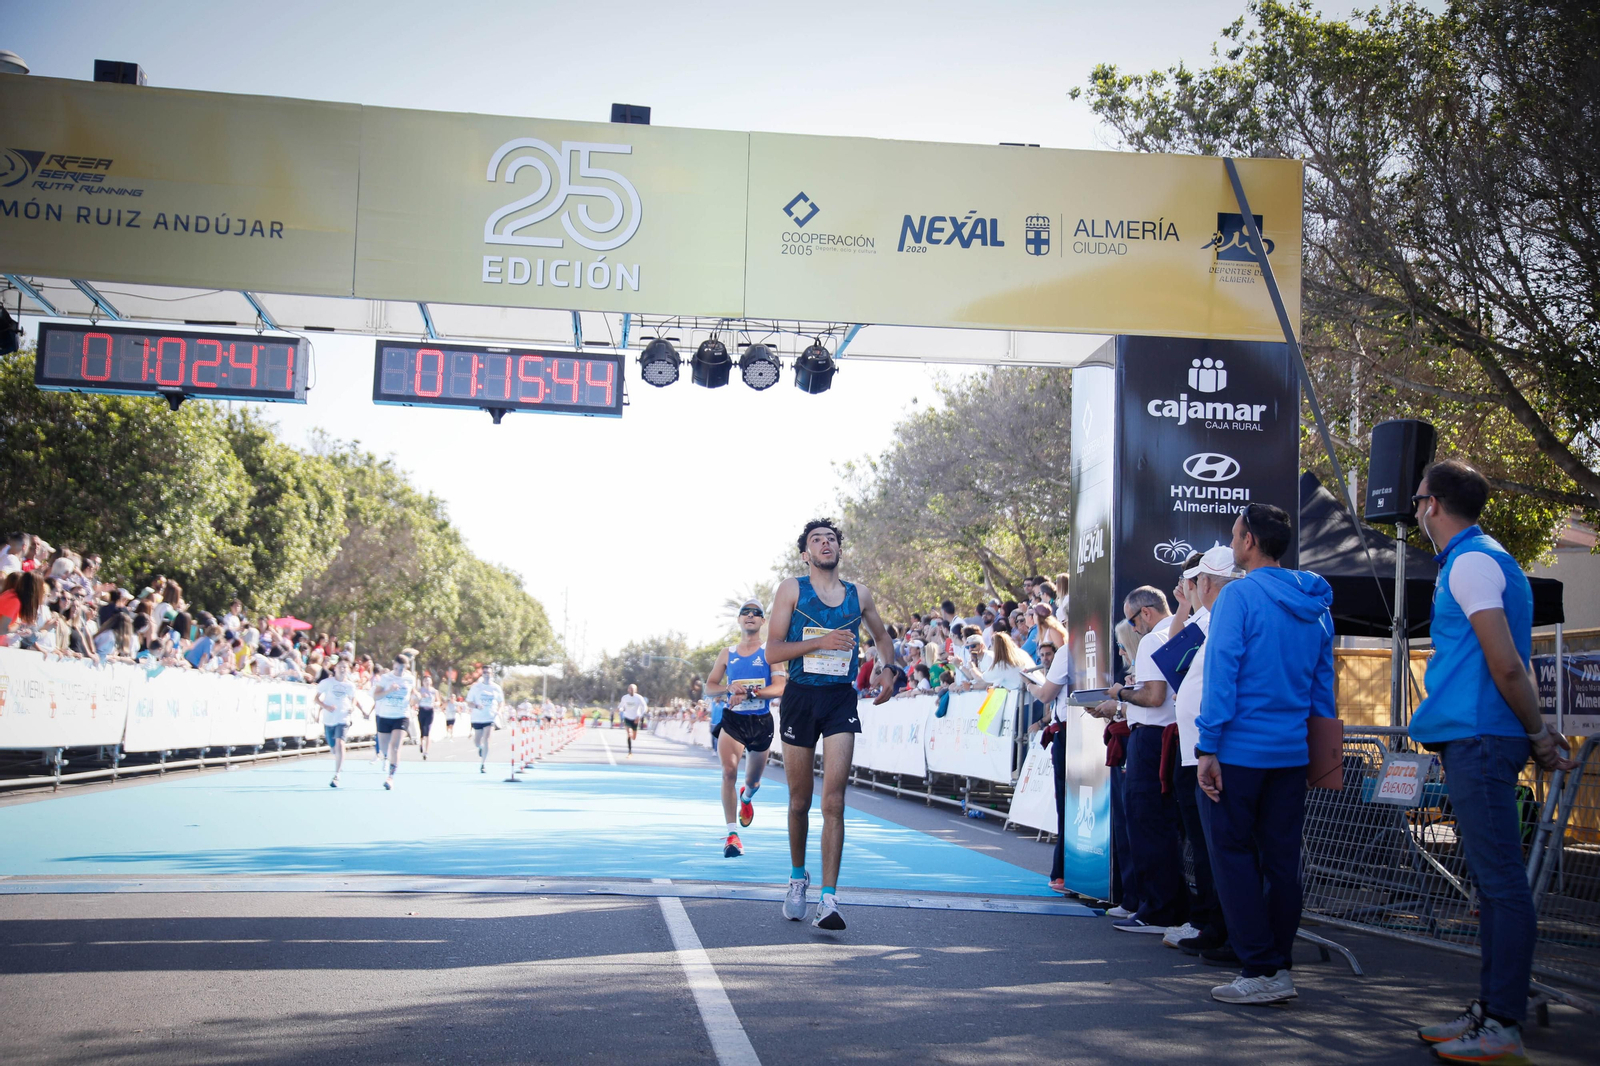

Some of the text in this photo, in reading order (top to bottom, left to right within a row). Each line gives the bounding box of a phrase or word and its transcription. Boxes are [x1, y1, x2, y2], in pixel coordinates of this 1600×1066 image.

[39, 169, 106, 183] SERIES
[32, 181, 144, 197] RUTA RUNNING
[484, 137, 642, 251] 25
[0, 198, 284, 239] MÓN RUIZ ANDÚJAR
[1073, 217, 1180, 241] ALMERÍA
[781, 231, 875, 248] COOPERACIÓN
[781, 243, 813, 256] 2005
[906, 245, 927, 253] 2020
[1072, 241, 1128, 256] CIUDAD
[482, 254, 640, 291] EDICIÓN
[1208, 266, 1252, 276] DEPORTES
[81, 331, 294, 390] 01:02:41
[414, 348, 614, 405] 01:15:44
[1147, 393, 1267, 426] cajamar
[1205, 420, 1264, 432] CAJA RURAL
[1170, 484, 1250, 500] HYUNDAI
[1381, 781, 1416, 795] EVENTOS
